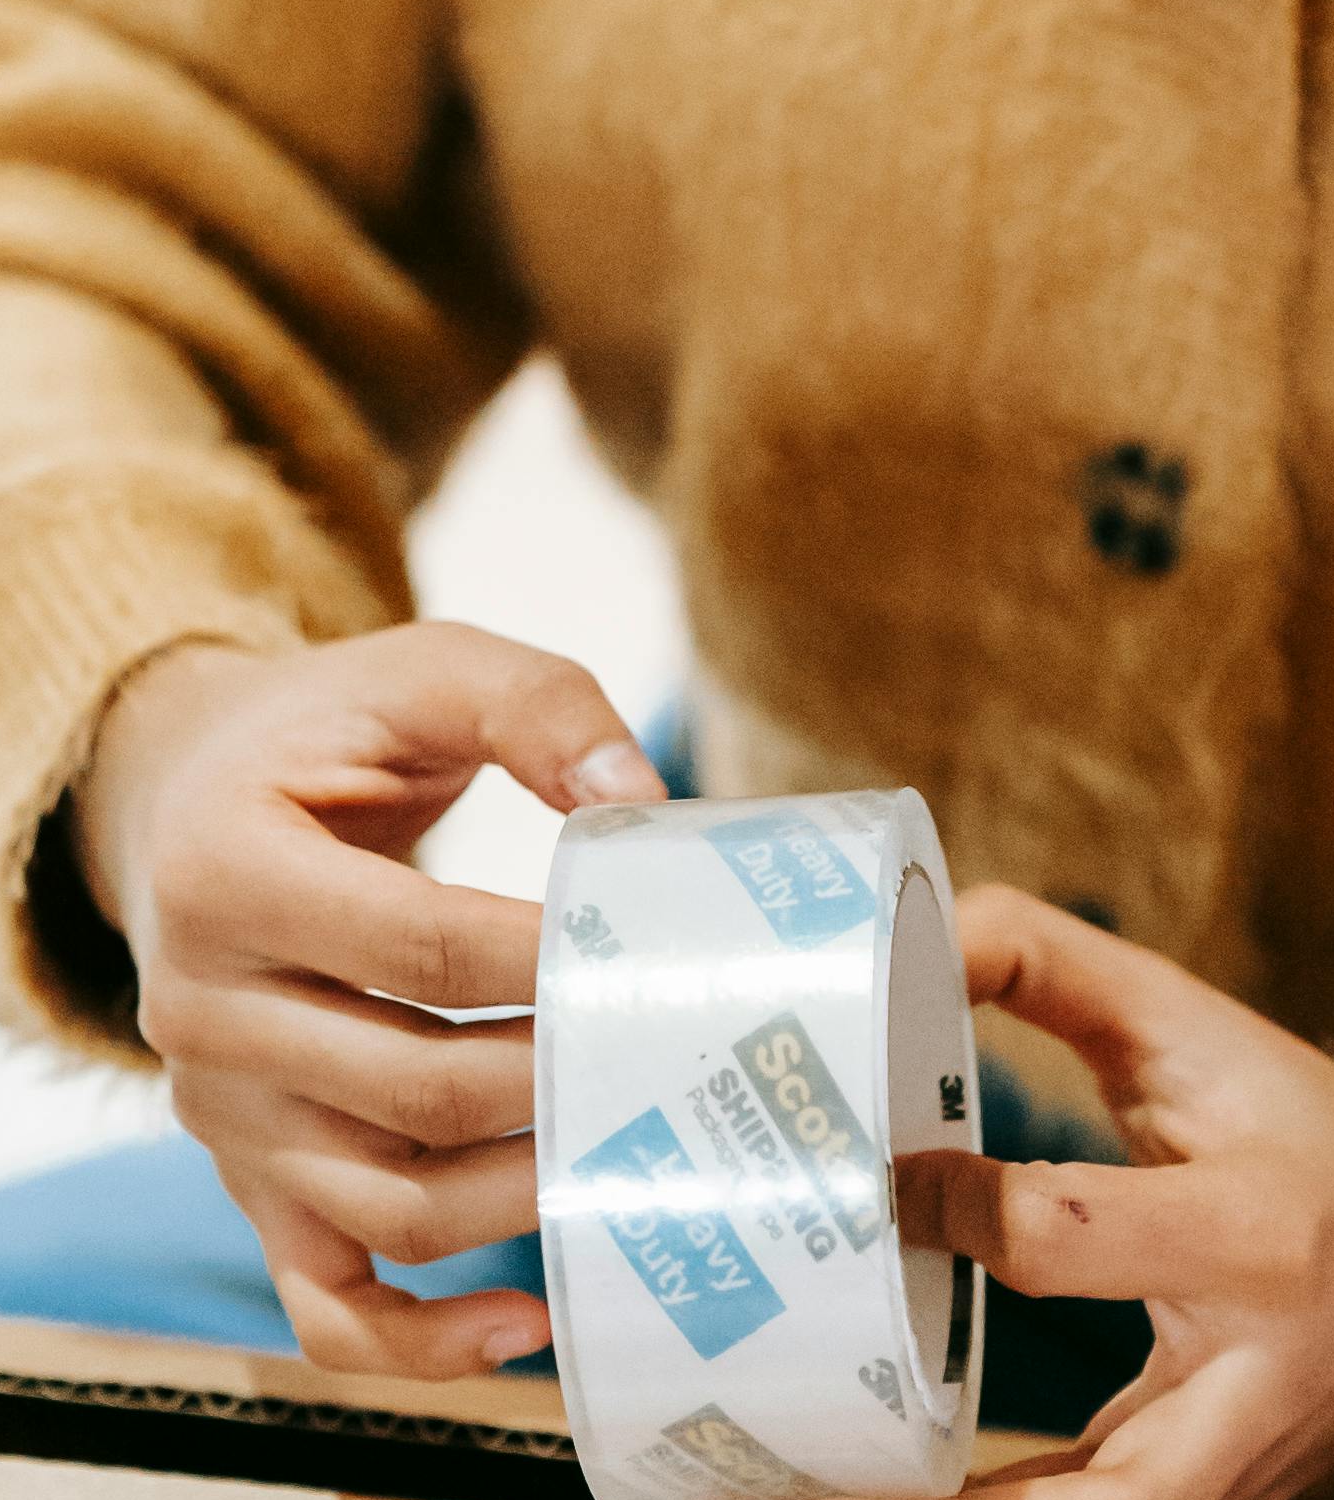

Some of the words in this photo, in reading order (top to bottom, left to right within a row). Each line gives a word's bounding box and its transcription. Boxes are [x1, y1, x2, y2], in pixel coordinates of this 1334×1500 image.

[737, 843, 800, 910] Duty
[563, 903, 624, 960] 3M
[940, 1073, 965, 1121] 3M
[708, 1067, 837, 1265] SHIPNG
